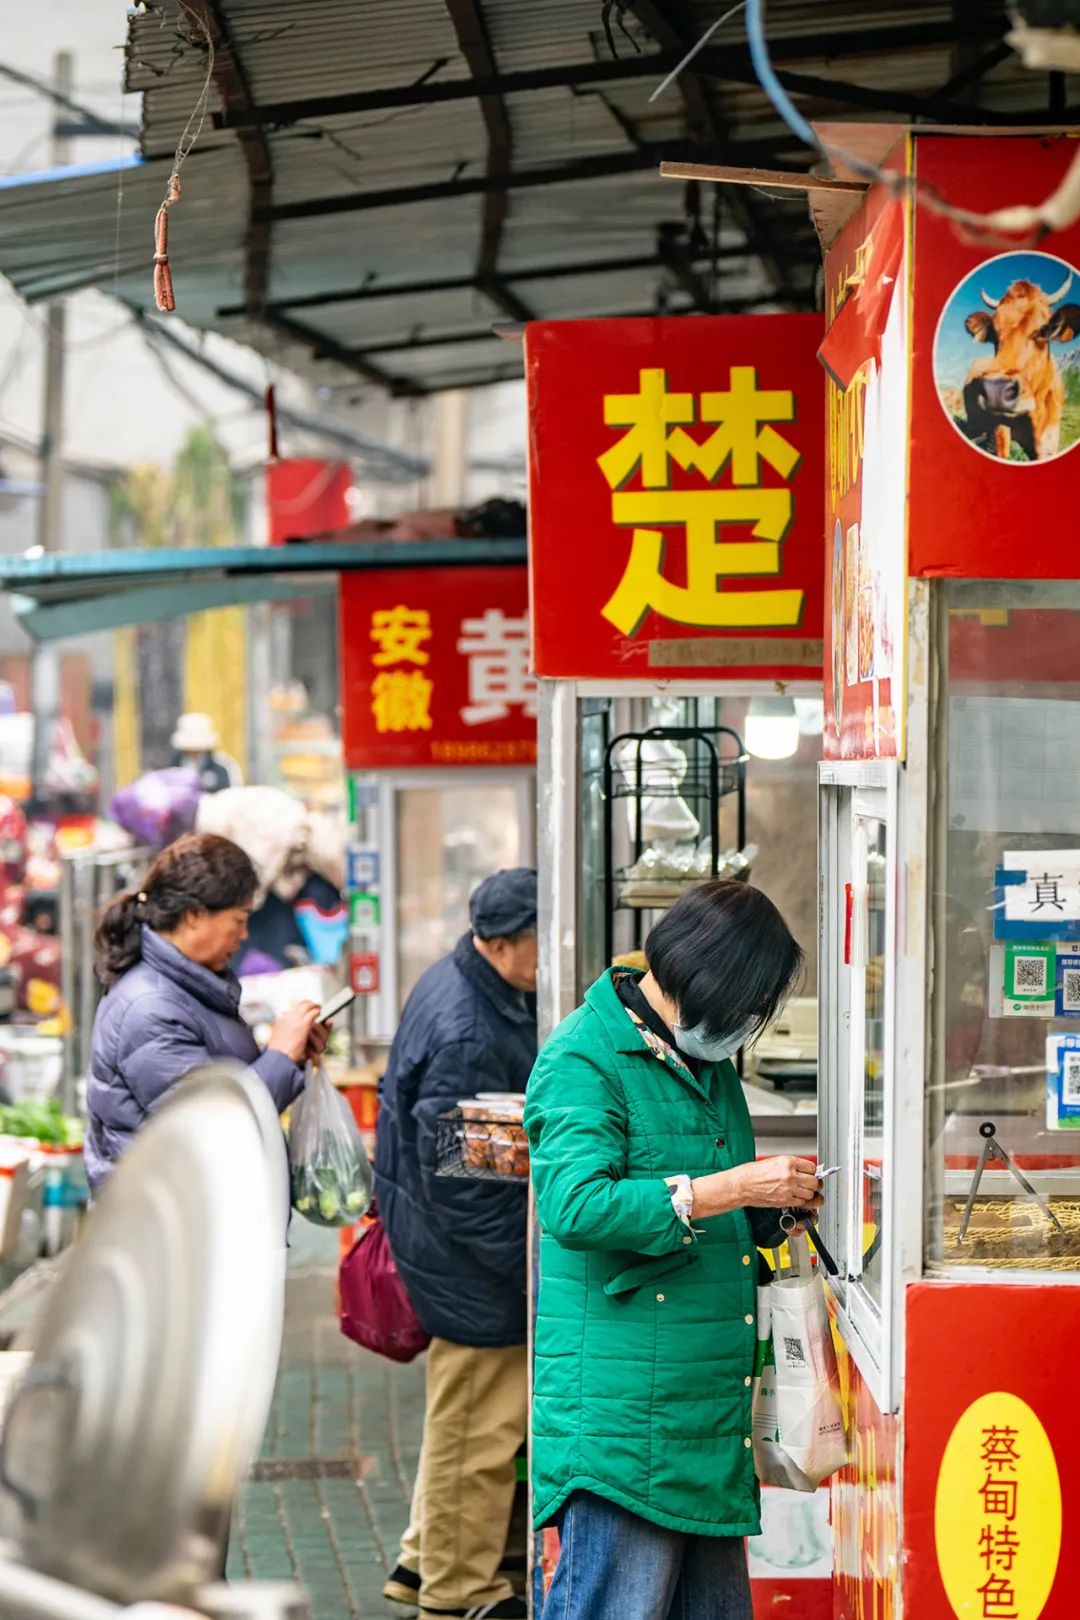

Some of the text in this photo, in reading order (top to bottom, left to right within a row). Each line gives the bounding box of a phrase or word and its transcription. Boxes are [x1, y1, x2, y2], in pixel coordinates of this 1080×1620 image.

[596, 366, 805, 638] 楚
[369, 605, 434, 733] 安徽
[456, 608, 537, 726] 黄
[1028, 872, 1080, 913] 真
[977, 1425, 1021, 1619] 蔡甸特色
